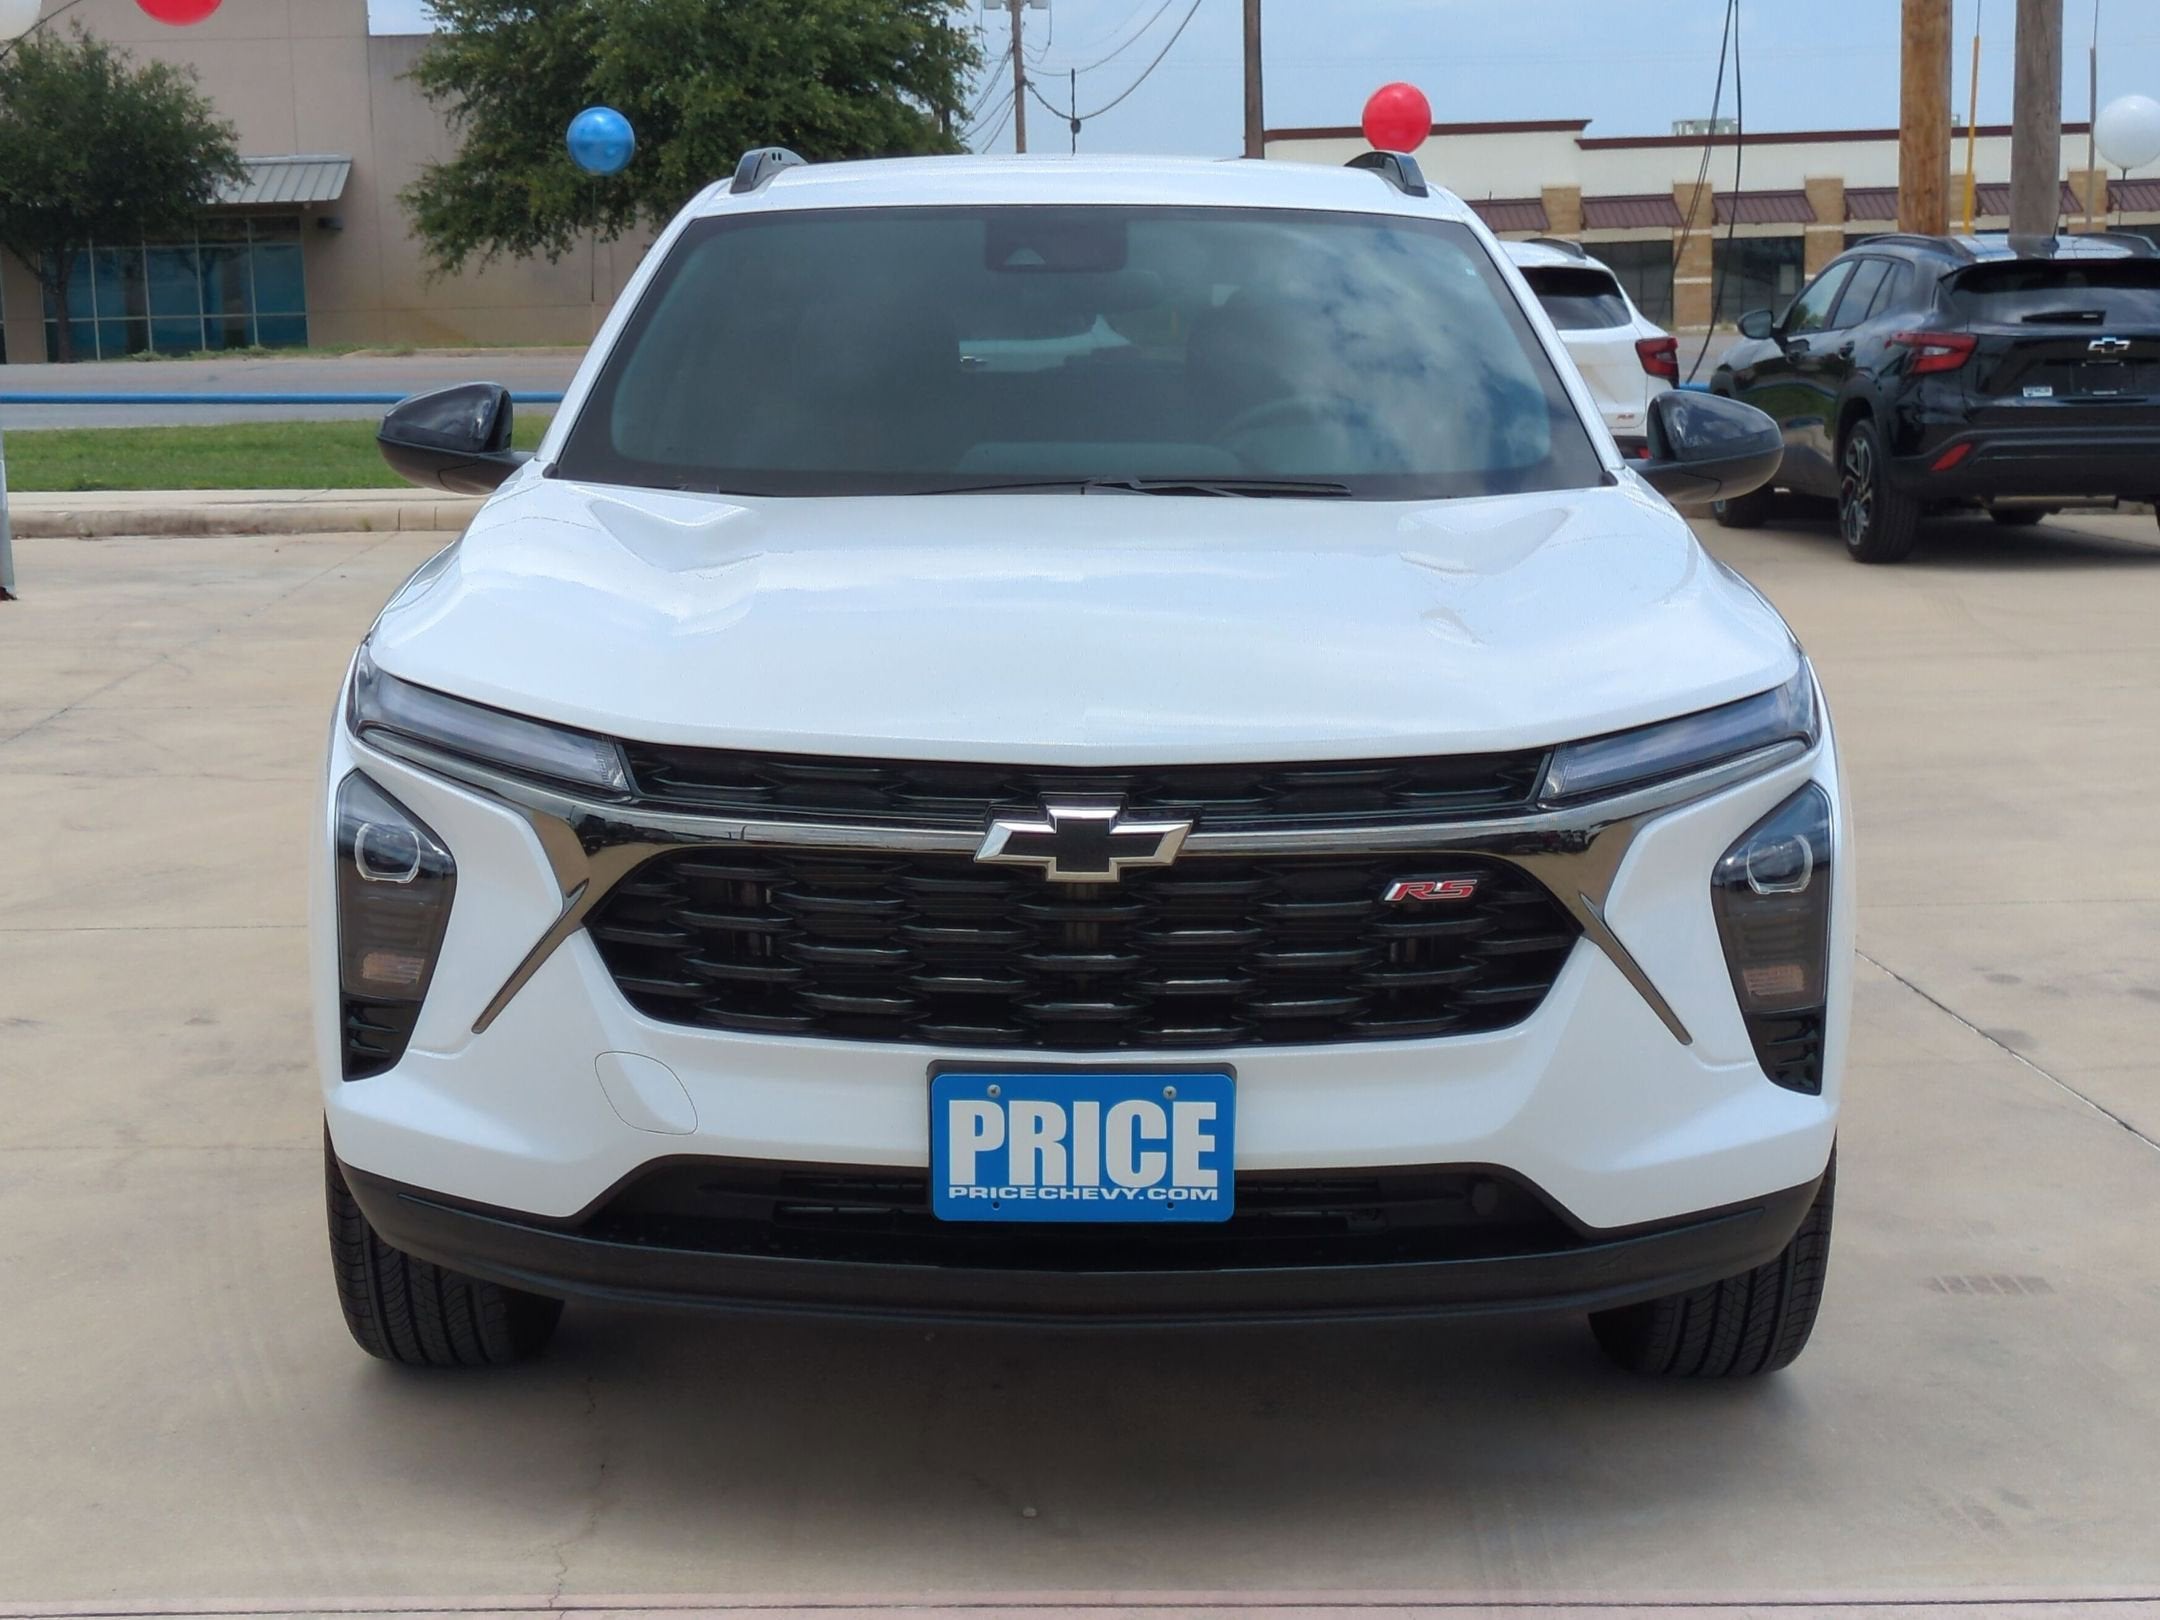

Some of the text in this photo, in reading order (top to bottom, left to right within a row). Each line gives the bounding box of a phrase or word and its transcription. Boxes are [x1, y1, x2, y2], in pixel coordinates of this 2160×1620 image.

[1384, 879, 1478, 901] RS
[949, 1100, 1218, 1188] PRICE
[949, 1186, 1218, 1201] PRICECHEVY.COM
